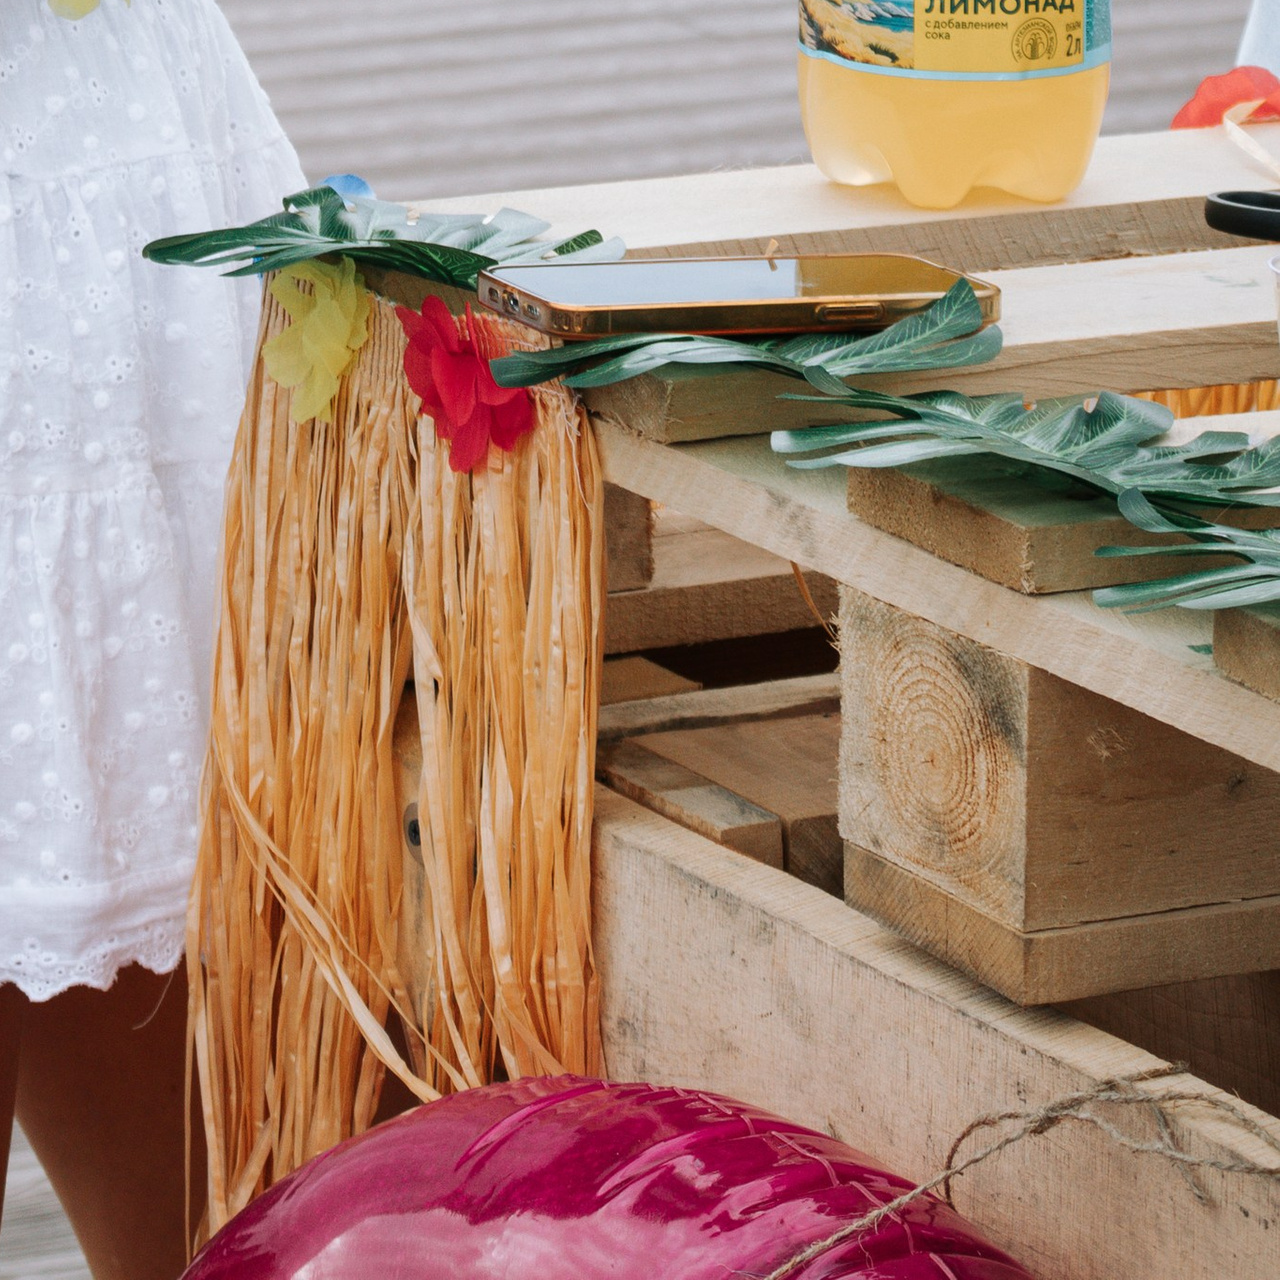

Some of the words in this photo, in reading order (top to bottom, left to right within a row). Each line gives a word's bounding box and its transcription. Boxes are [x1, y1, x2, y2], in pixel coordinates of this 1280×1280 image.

[924, 20, 931, 29] с
[933, 18, 1009, 30] добавлением
[924, 31, 951, 40] сока
